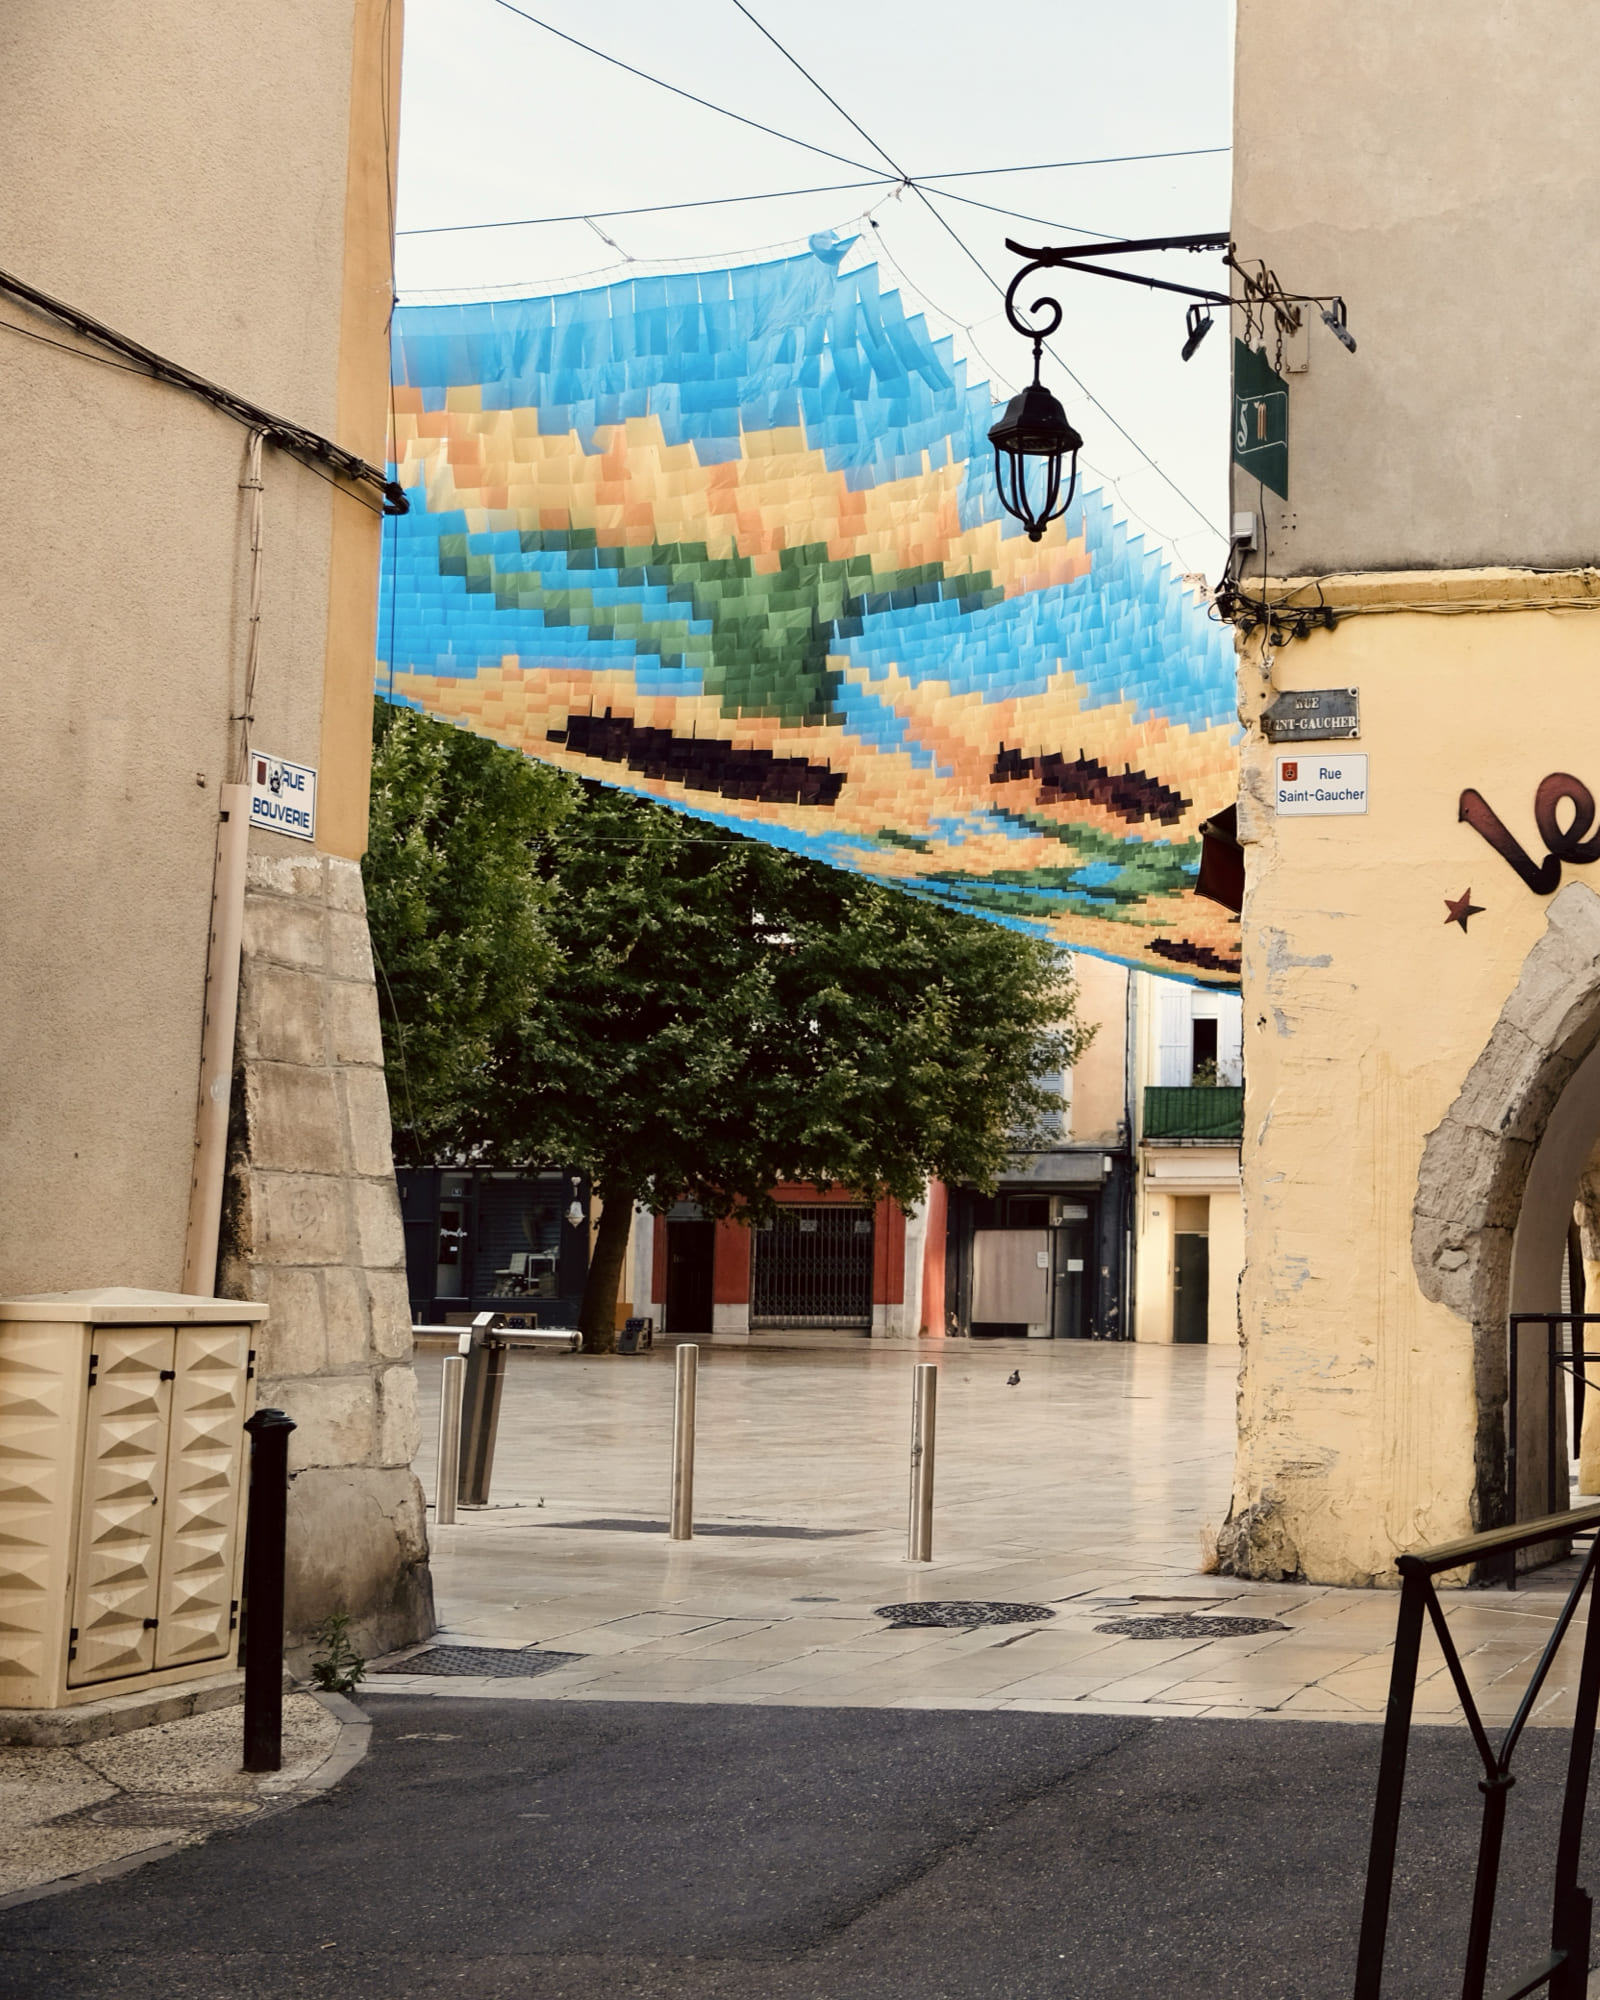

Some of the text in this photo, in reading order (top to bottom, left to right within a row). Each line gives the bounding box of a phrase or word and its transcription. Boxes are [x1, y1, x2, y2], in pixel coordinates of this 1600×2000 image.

[1295, 697, 1319, 709] RUE
[1263, 716, 1356, 731] INT-GAUCHER
[281, 770, 305, 791] RUE
[1319, 767, 1342, 780] Rue
[1279, 788, 1365, 803] Saint-Gaucher
[252, 797, 310, 828] BOUVERIE
